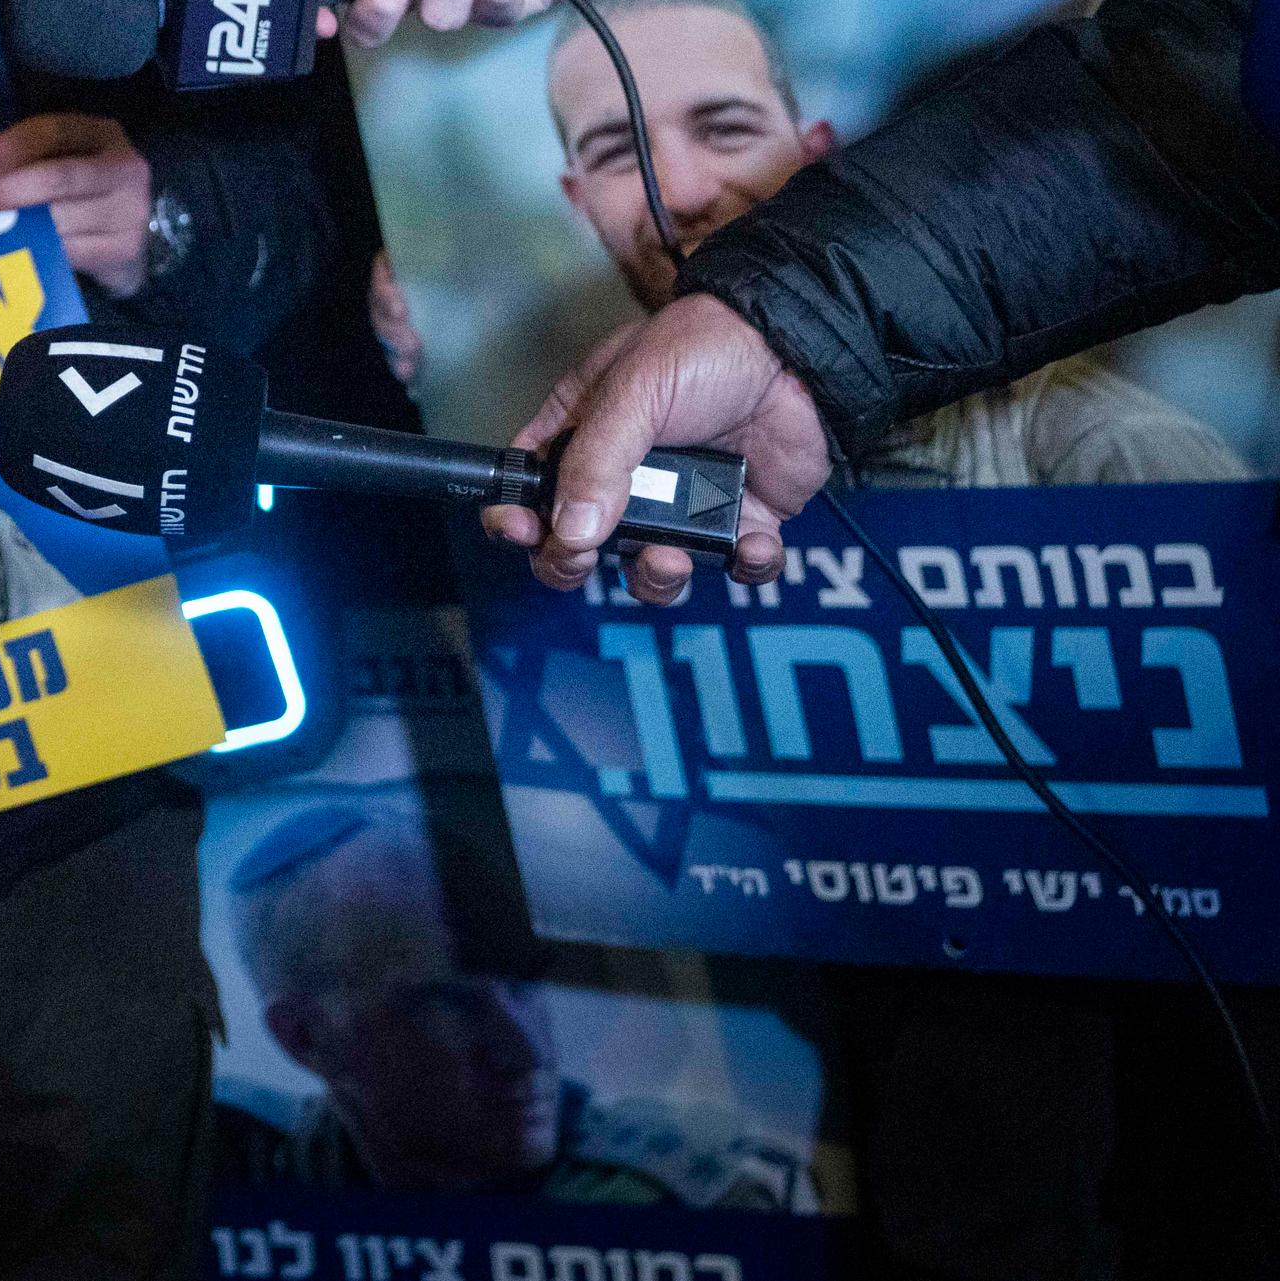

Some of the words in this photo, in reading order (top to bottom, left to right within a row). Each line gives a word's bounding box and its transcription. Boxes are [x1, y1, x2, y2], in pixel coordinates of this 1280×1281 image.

[255, 20, 271, 59] NEWS
[166, 343, 207, 443] חדשות
[901, 544, 1224, 610] במותם
[598, 624, 1243, 800] ניצחון
[783, 858, 983, 910] פיטוסי
[1003, 868, 1101, 912] ישי
[210, 1220, 316, 1278] לנו
